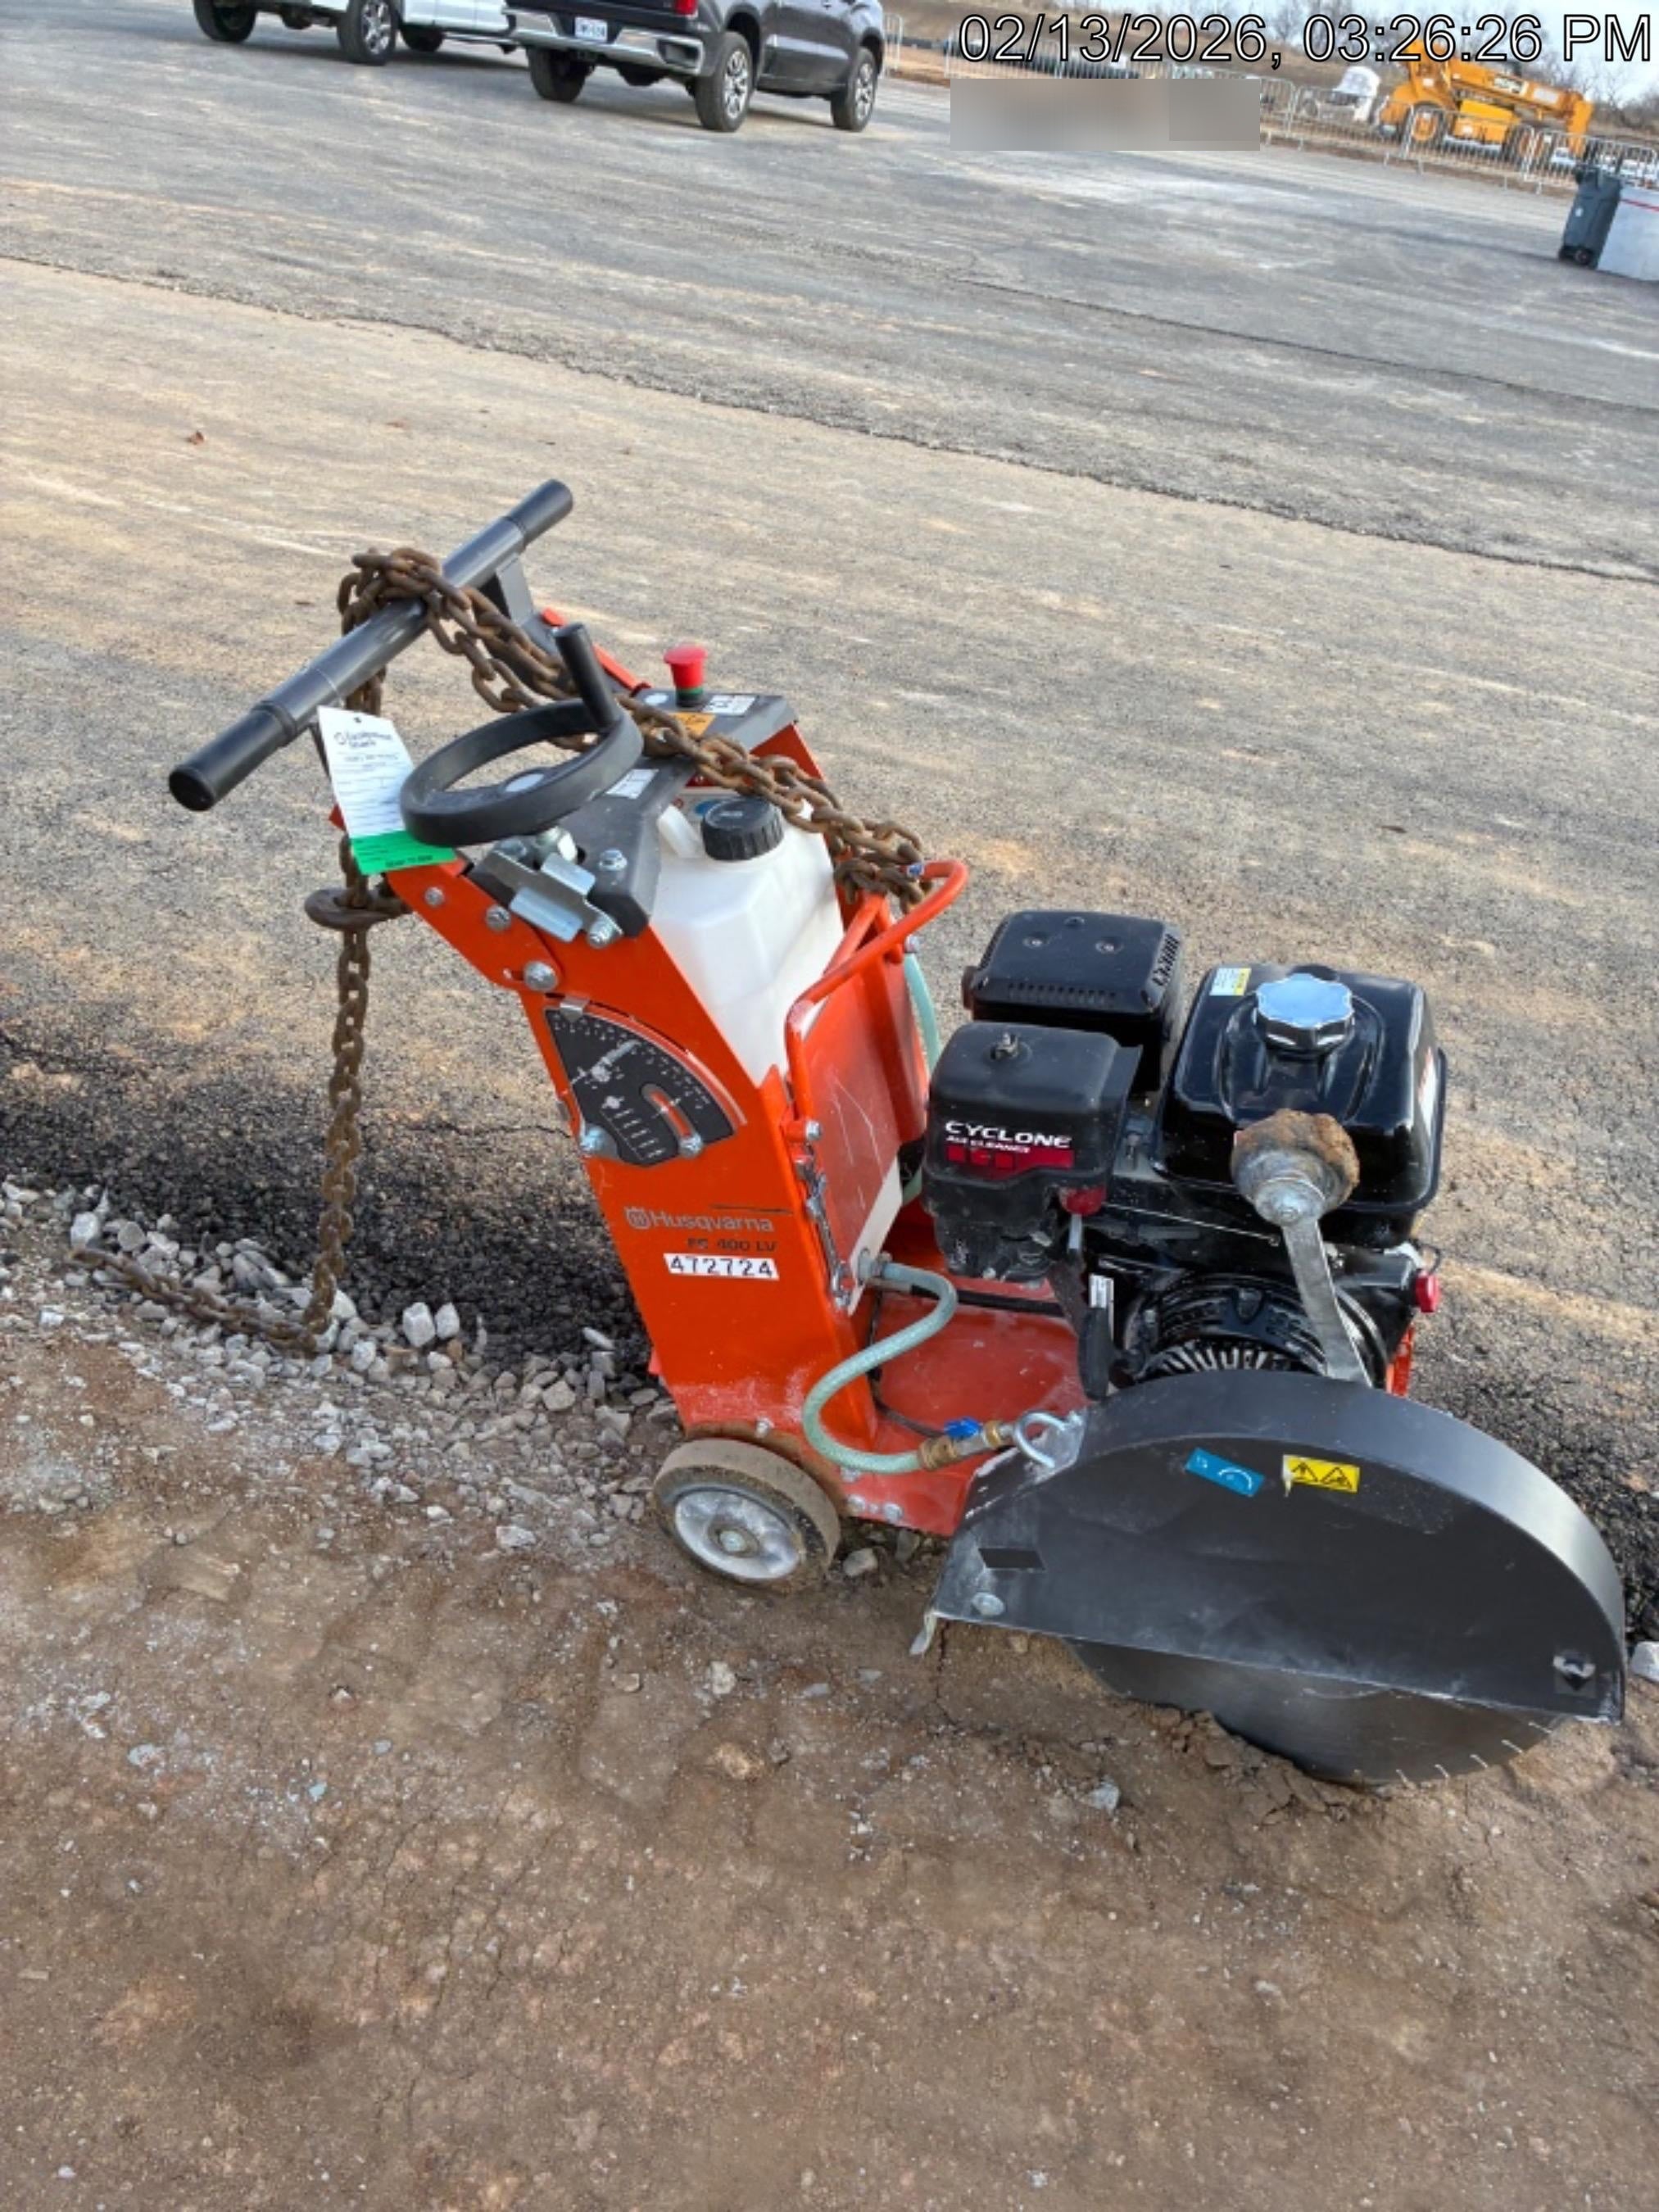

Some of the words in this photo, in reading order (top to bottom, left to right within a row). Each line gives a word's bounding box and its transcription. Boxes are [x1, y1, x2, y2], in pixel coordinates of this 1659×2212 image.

[945, 1120, 1072, 1149] CYCLONE
[650, 1211, 773, 1232] Husqvarna
[718, 1239, 750, 1252] 400
[670, 1255, 773, 1277] 472724
